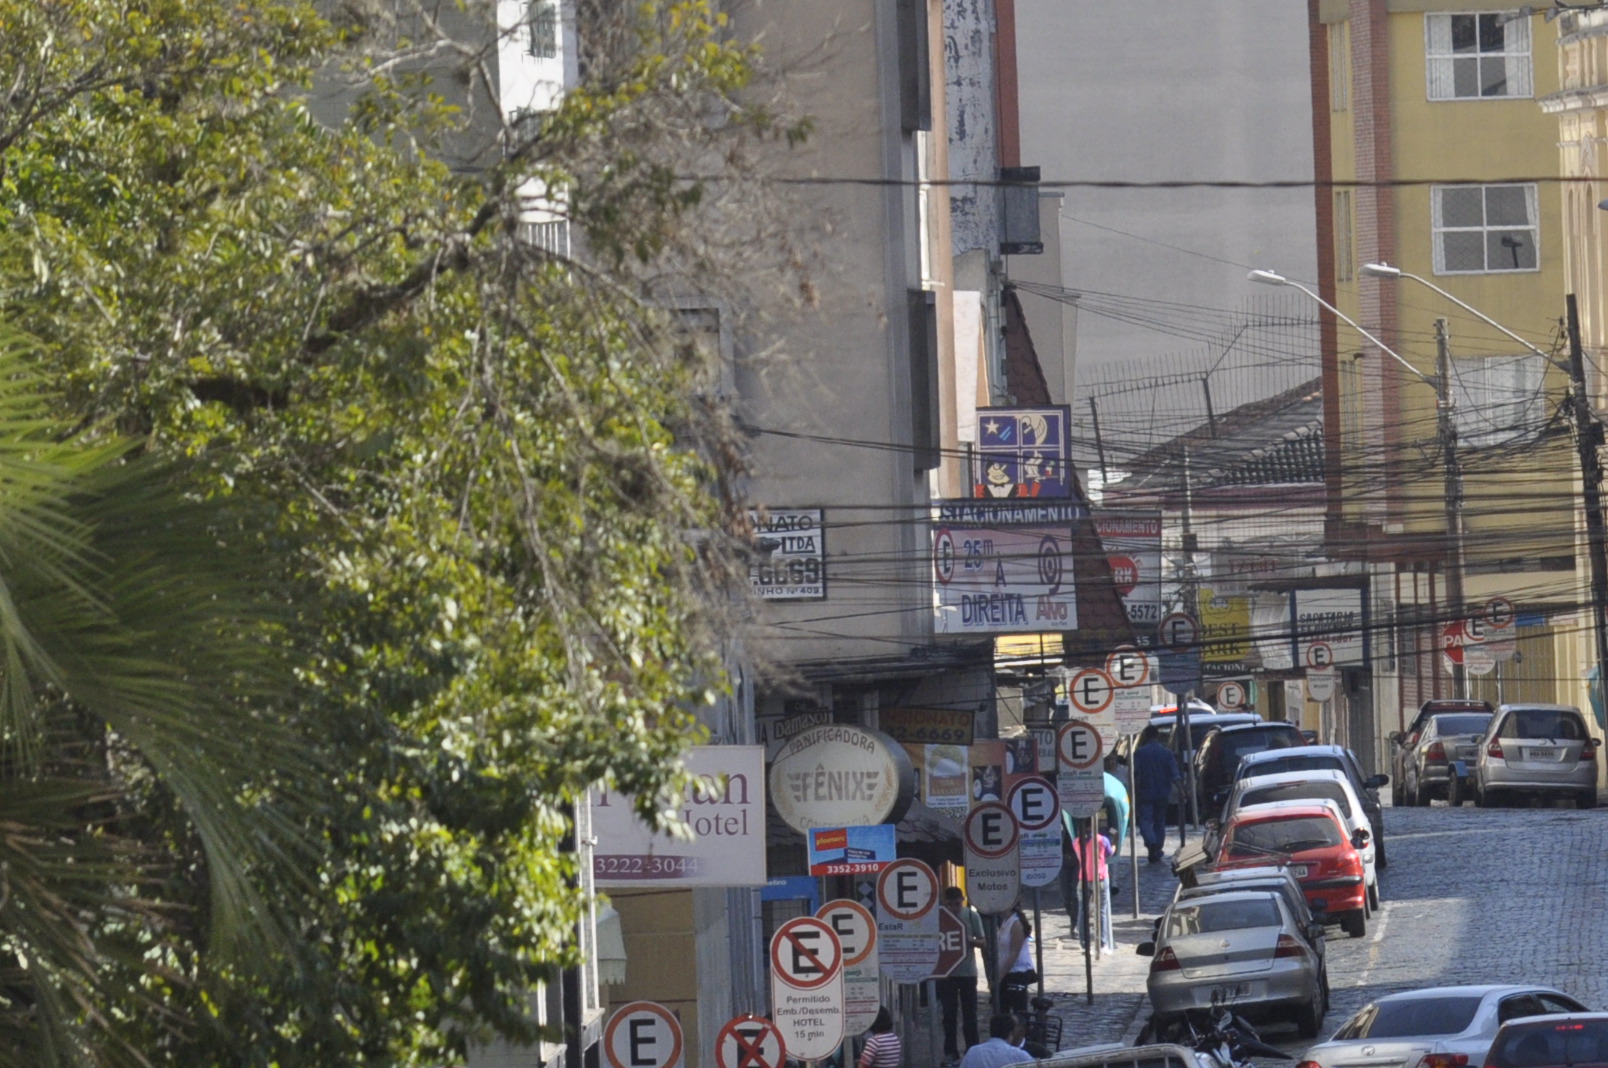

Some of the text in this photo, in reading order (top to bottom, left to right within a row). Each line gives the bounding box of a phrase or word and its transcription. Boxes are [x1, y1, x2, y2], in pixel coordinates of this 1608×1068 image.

[961, 593, 1028, 626] DIREITA
[1444, 636, 1464, 648] PA
[1314, 648, 1325, 666] E
[1120, 655, 1134, 680] E
[1084, 678, 1099, 704] E
[1226, 688, 1236, 704] E
[789, 728, 875, 755] PANIFICADORA
[1071, 731, 1087, 759] E
[801, 764, 866, 801] FÊNIX
[1021, 788, 1044, 821] E
[982, 814, 1002, 845] E
[596, 857, 699, 873] 3222-3044
[827, 863, 879, 873] 3352-3910
[969, 868, 1016, 877] Exclusivo
[897, 872, 918, 908] E
[978, 883, 1008, 891] Motos
[832, 914, 855, 954] E
[878, 923, 903, 931] EstaR
[938, 931, 961, 951] RE
[786, 995, 831, 1004] Permitido
[793, 1018, 825, 1028] HOTEL
[629, 1018, 657, 1067] E
[794, 1030, 825, 1039] 15 min
